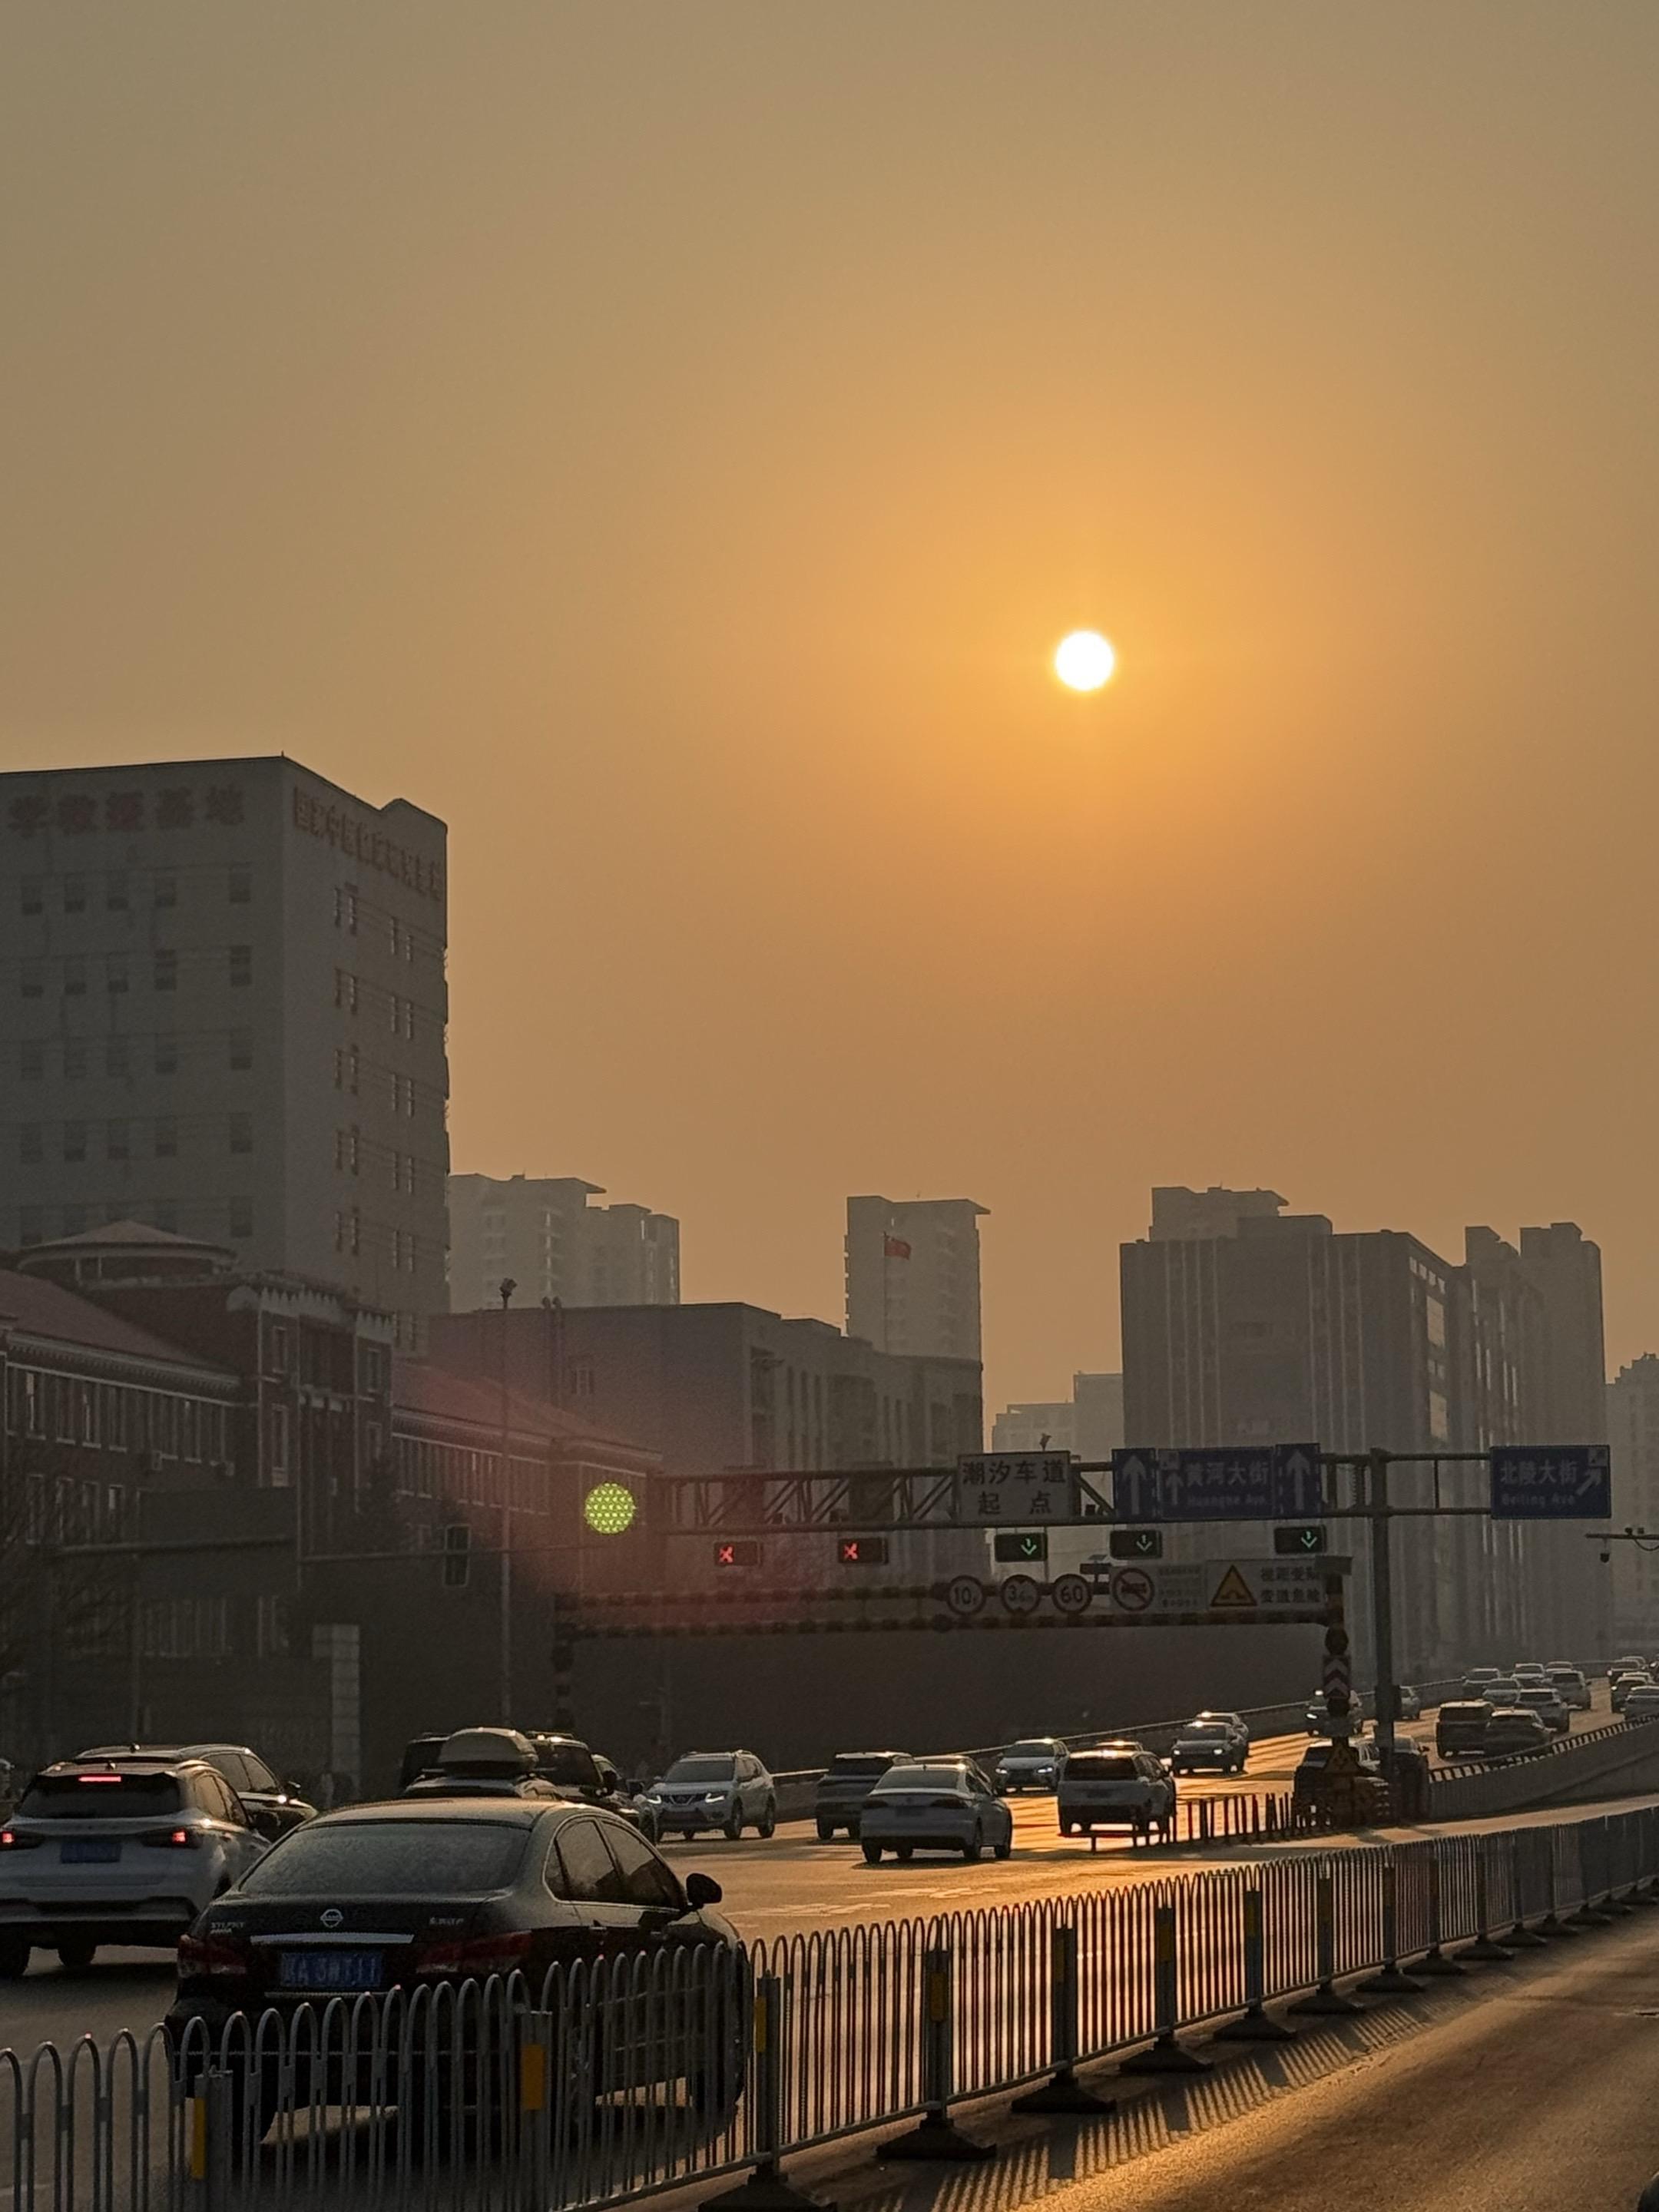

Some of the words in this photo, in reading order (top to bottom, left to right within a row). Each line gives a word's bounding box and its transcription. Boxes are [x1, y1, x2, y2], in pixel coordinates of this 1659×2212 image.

[962, 1459, 1066, 1485] 潮汐车道
[1184, 1460, 1270, 1487] 黄河大街
[1499, 1459, 1578, 1485] 北陵大街
[1061, 1585, 1083, 1604] 60
